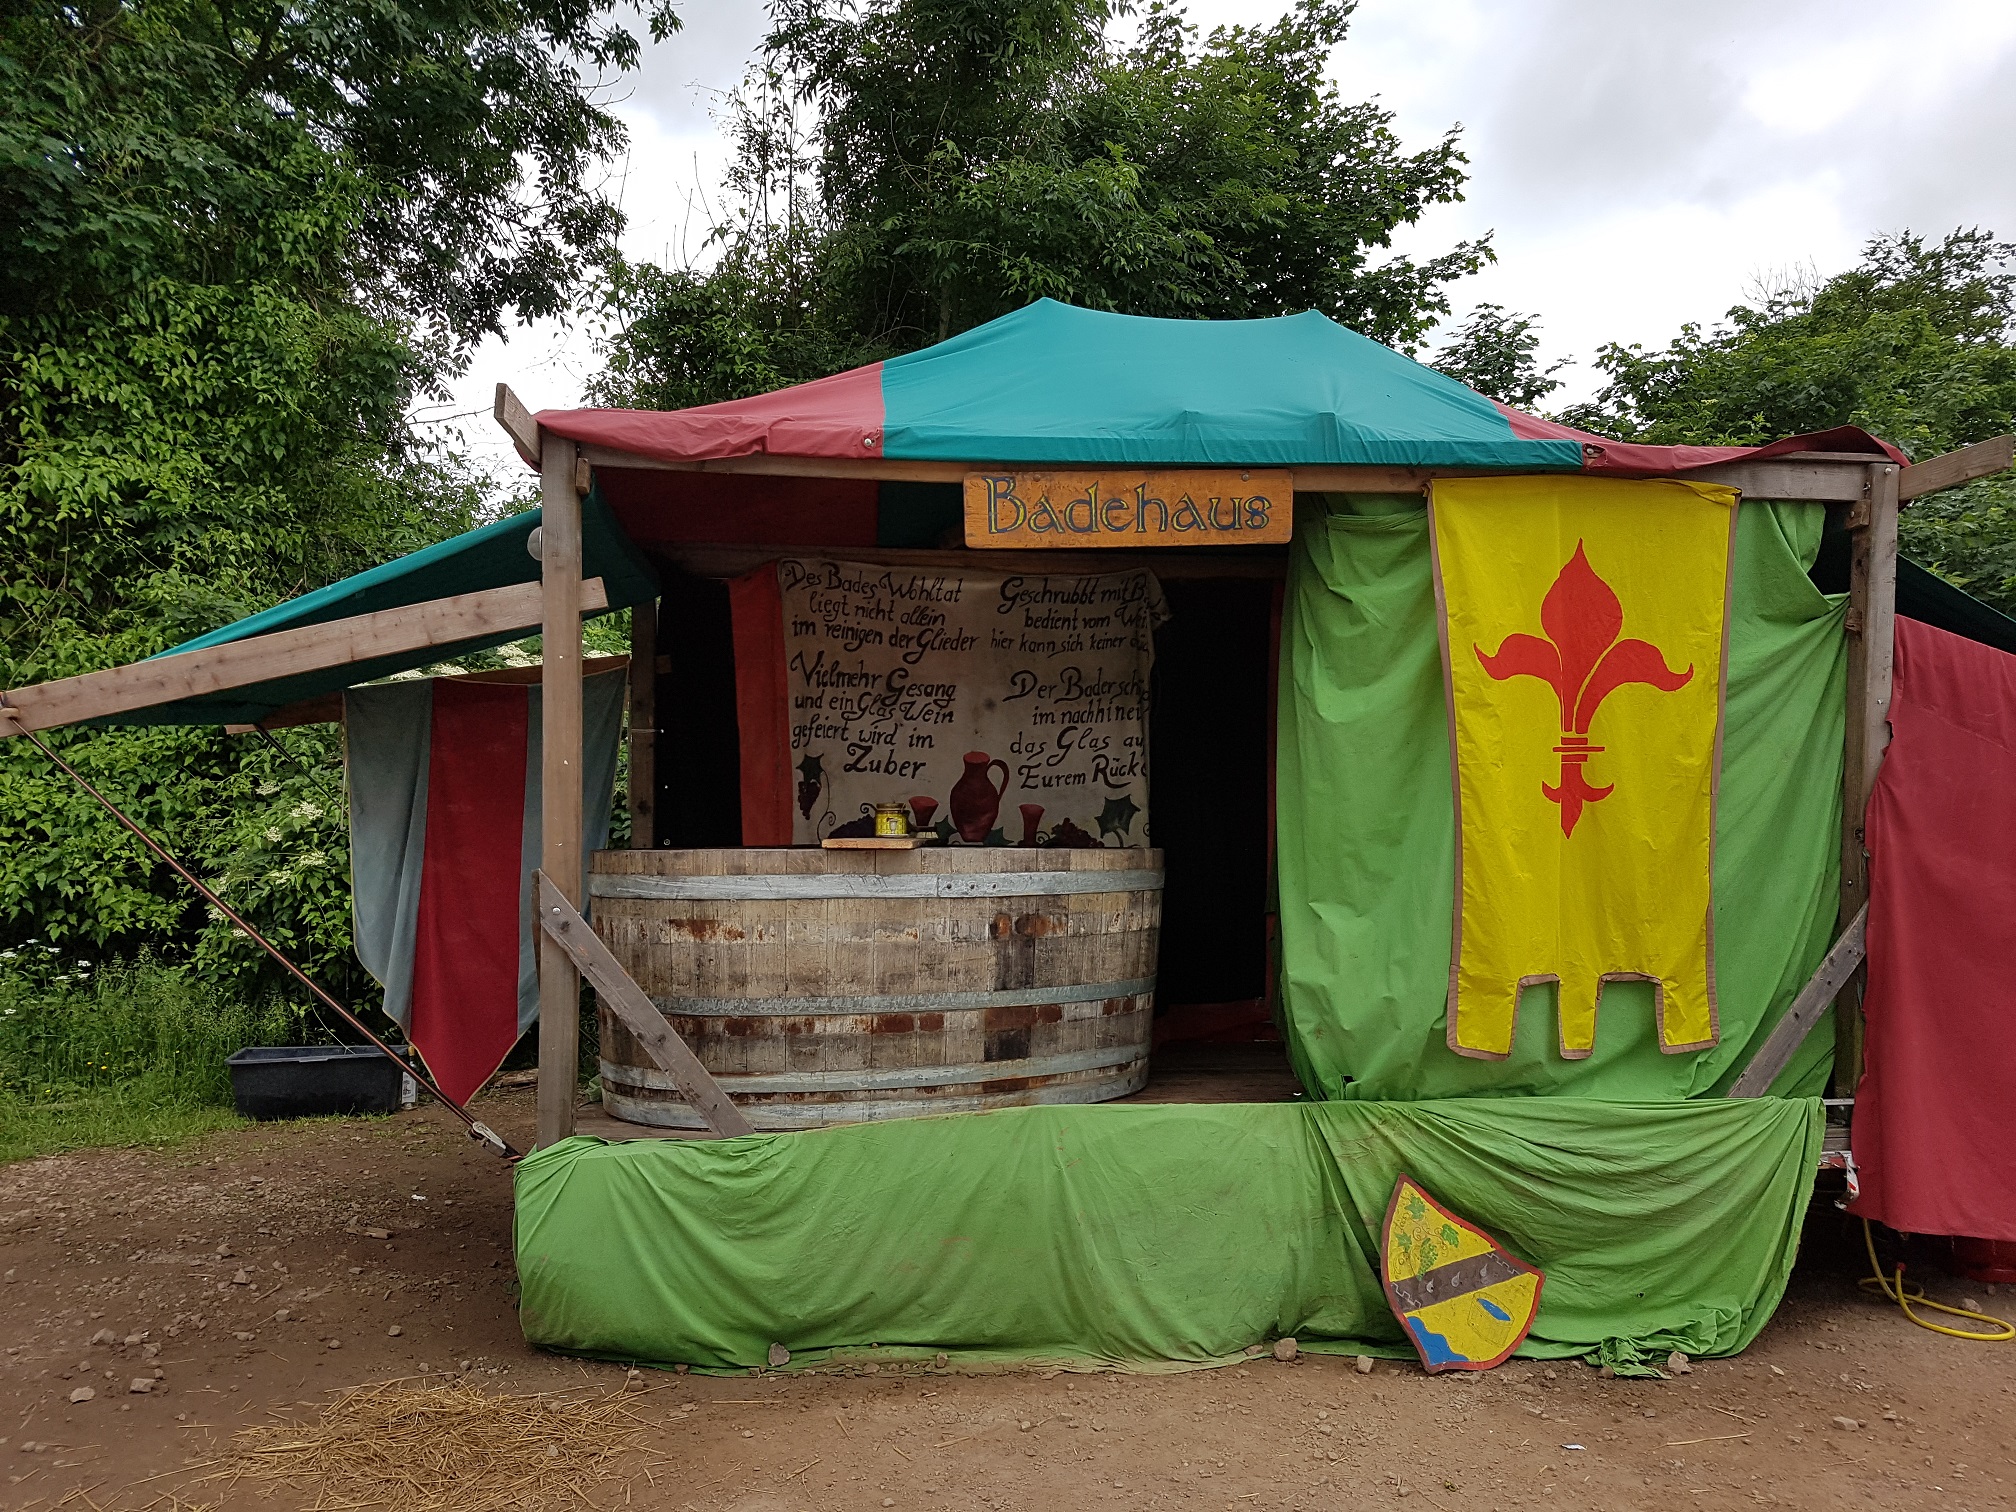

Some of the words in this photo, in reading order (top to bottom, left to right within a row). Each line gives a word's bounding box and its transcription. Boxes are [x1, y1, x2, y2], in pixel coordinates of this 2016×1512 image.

[982, 475, 1273, 534] Badehaus
[782, 560, 822, 591] Des
[820, 561, 878, 599] Bades
[879, 571, 964, 603] Wohltat
[997, 576, 1100, 614] Geschrubbt
[1101, 577, 1130, 602] mit
[792, 614, 816, 637] im
[810, 591, 850, 622] liegt
[854, 598, 894, 622] nicht
[901, 605, 946, 626] allein
[1024, 607, 1079, 631] bedient
[1082, 615, 1111, 630] vom
[824, 620, 883, 652] reinigen
[889, 626, 916, 649] der
[902, 627, 980, 664] Glieder
[990, 627, 1015, 650] hier
[1019, 633, 1056, 653] kann
[1047, 632, 1083, 658] sich
[1090, 632, 1127, 651] keiner
[790, 650, 883, 689] Vielmehr
[880, 667, 957, 709] Gesang
[1002, 669, 1058, 703] Der
[1054, 666, 1117, 704] Bader
[795, 689, 825, 710] und
[829, 691, 854, 711] ein
[841, 691, 896, 726] Glas
[899, 700, 954, 725] Wein
[1032, 706, 1056, 726] im
[791, 713, 849, 749] gefeiert
[858, 723, 899, 746] wird
[908, 727, 935, 748] im
[1010, 731, 1047, 761] das
[1046, 725, 1111, 767] Glas
[843, 742, 927, 779] Zuber
[1018, 762, 1087, 789] Eurem
